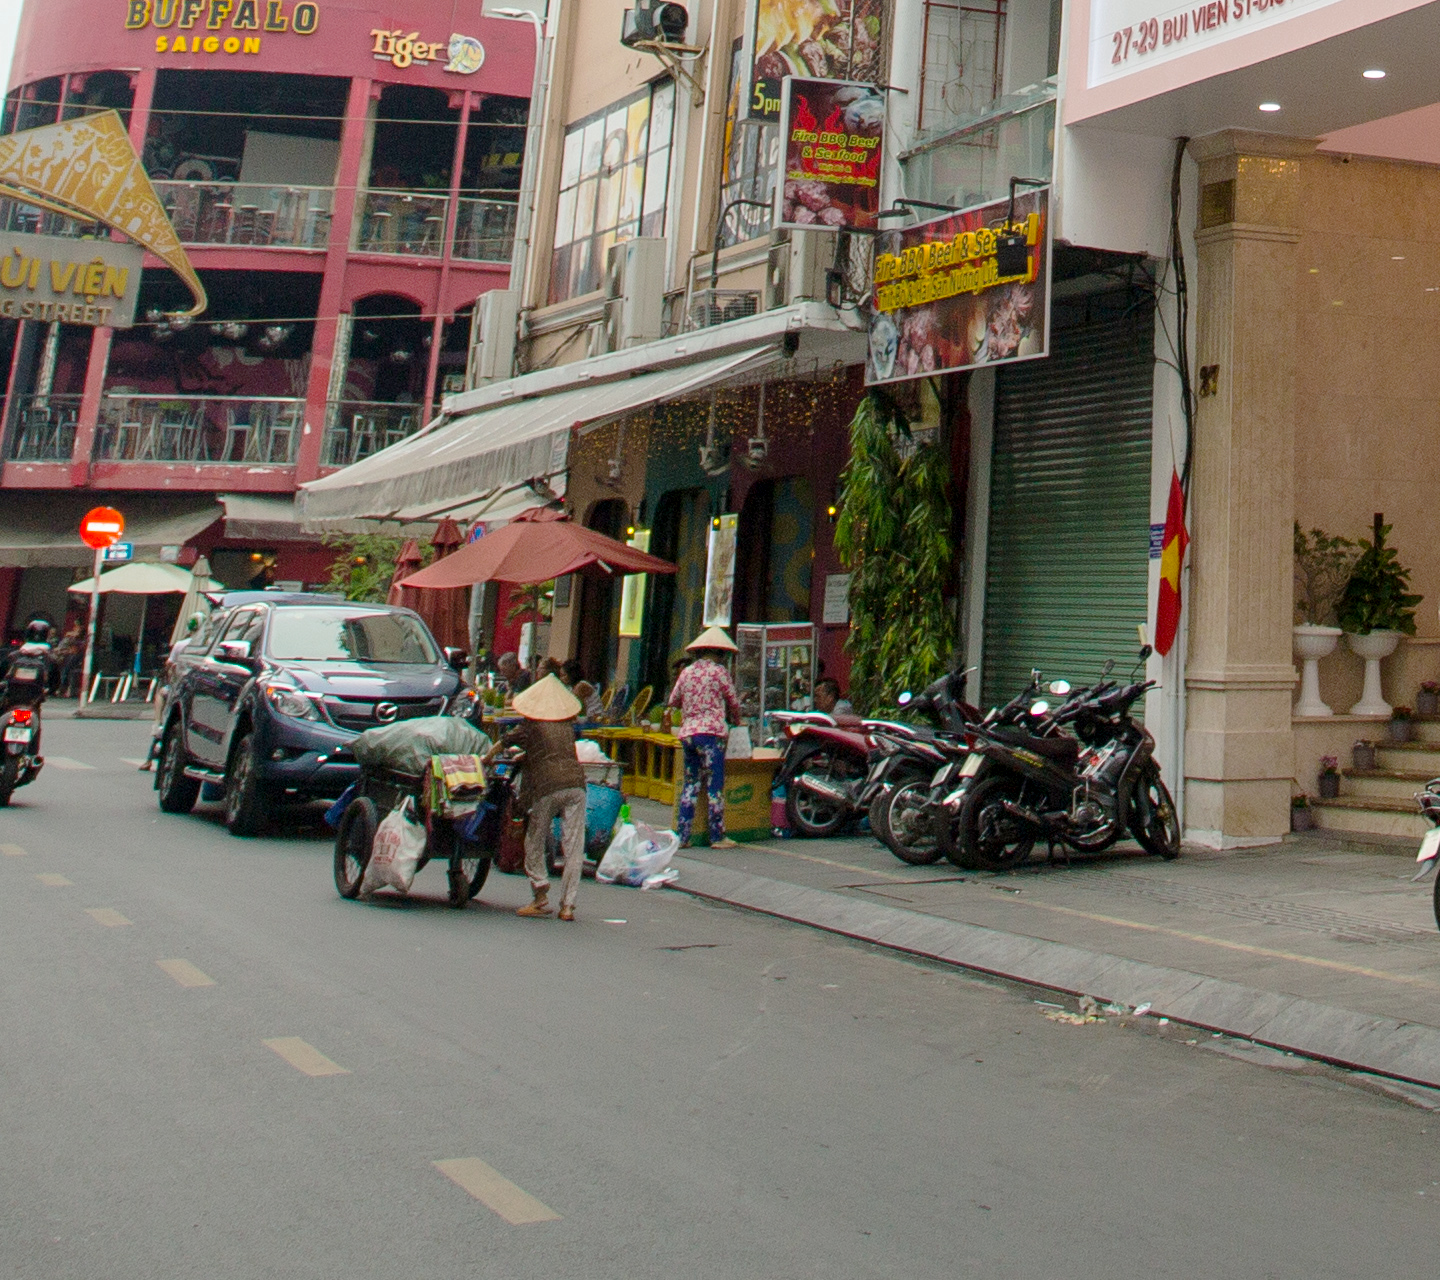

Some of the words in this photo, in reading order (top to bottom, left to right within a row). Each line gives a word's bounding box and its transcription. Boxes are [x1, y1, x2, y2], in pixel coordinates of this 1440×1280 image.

[154, 35, 261, 55] SAIGON
[370, 28, 444, 68] Tiger
[1111, 18, 1159, 65] 27-29
[1162, 13, 1188, 46] BUI
[792, 129, 817, 142] Fire
[819, 131, 848, 147] BBQ
[51, 256, 130, 302] VIỆN
[22, 300, 113, 326] STREET
